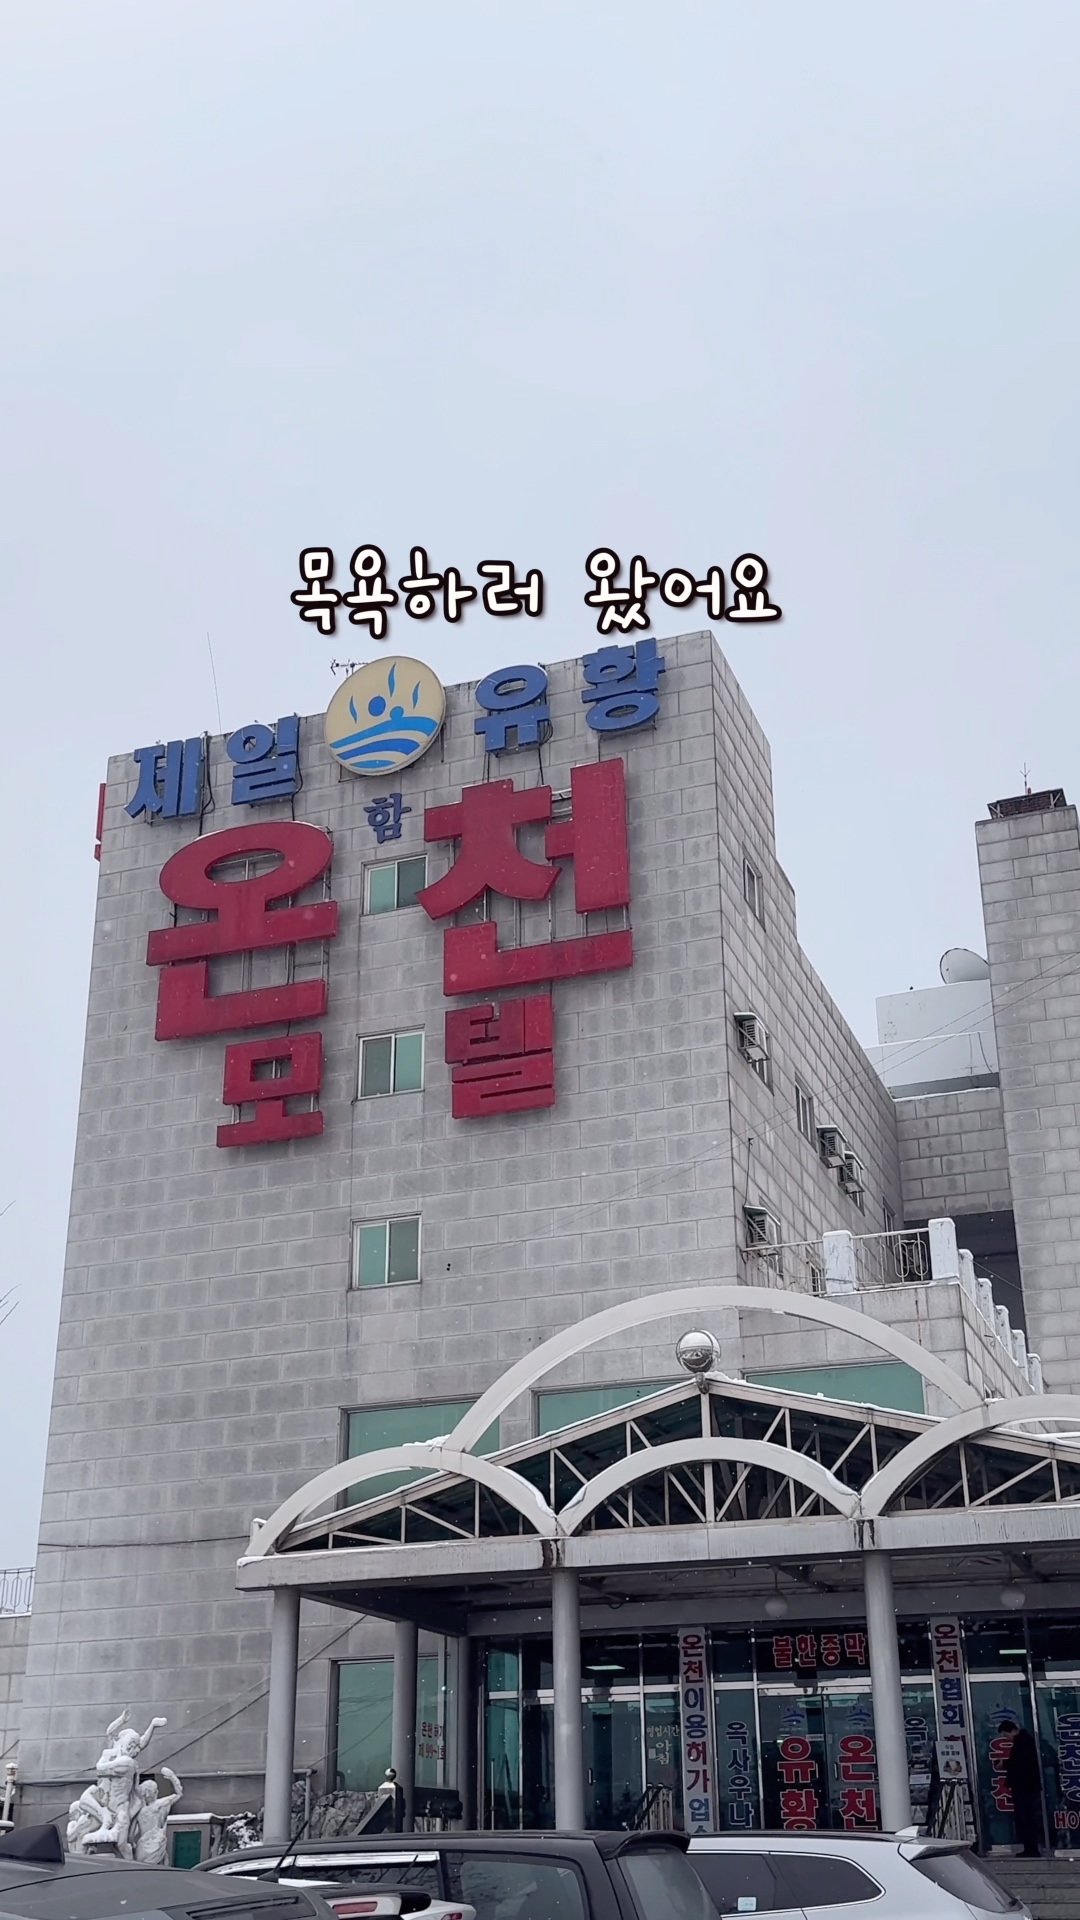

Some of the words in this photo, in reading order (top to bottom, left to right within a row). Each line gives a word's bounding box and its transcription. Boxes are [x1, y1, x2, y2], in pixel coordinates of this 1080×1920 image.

[124, 713, 300, 822] 제일
[473, 638, 666, 757] 유황
[363, 793, 413, 844] 함
[146, 757, 633, 1043] 온천
[217, 993, 556, 1149] 모텔
[773, 1632, 866, 1668] 불한증막
[646, 1724, 680, 1738] 영업시간
[725, 1721, 755, 1829] 옥사우나
[777, 1736, 819, 1830] 유황
[838, 1734, 878, 1830] 온천
[1053, 1811, 1080, 1829] HO
